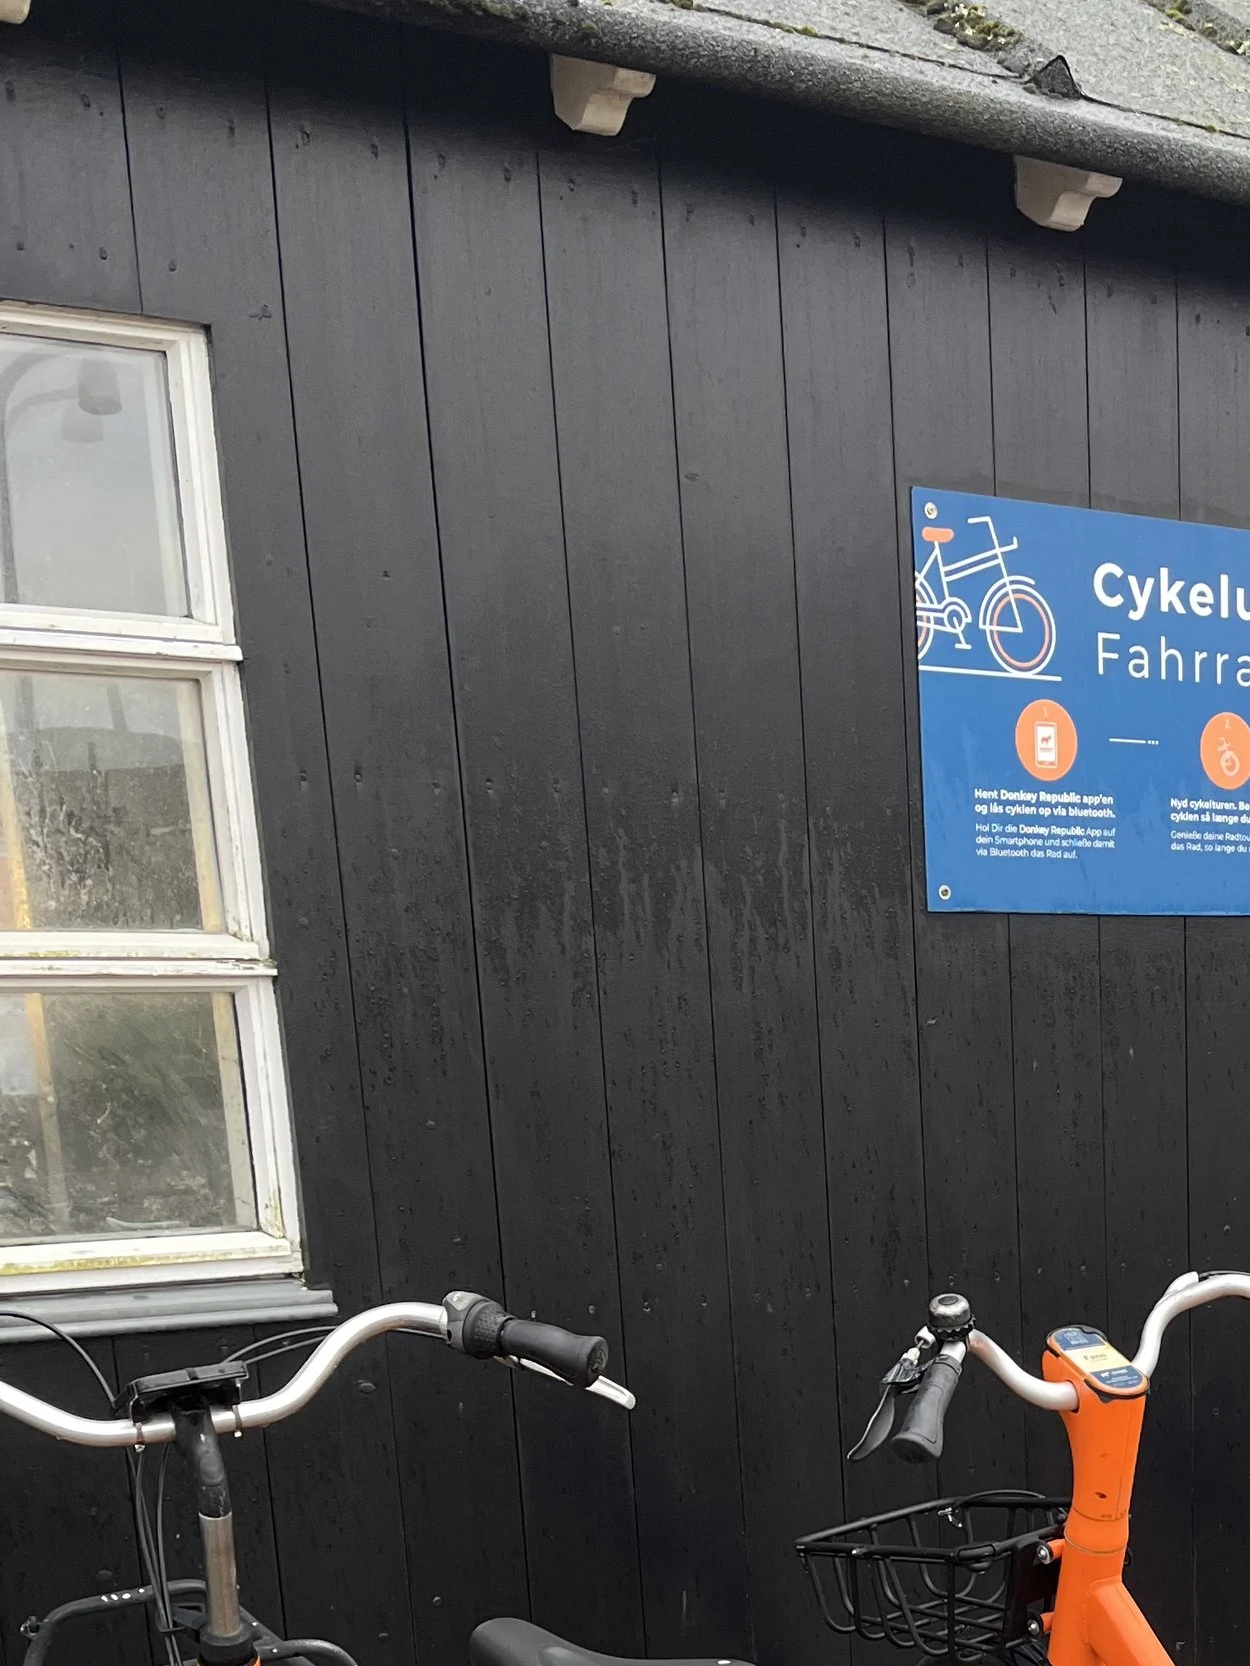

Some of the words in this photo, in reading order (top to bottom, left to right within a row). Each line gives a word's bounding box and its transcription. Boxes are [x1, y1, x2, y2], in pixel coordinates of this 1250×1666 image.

[974, 788, 998, 800] Hent
[1000, 789, 1037, 804] Donkey
[1039, 791, 1081, 804] Republic
[1082, 794, 1114, 806] app'en
[974, 804, 988, 815] og
[1005, 804, 1036, 816] cyklen
[1038, 807, 1051, 818] op
[1052, 805, 1067, 816] via
[1068, 806, 1116, 818] bluetooth.
[1170, 798, 1188, 810] Nyd
[1189, 799, 1237, 811] cykelturen.
[1170, 811, 1199, 823] cyklen
[1200, 811, 1210, 822] så
[1212, 812, 1238, 825] længe
[1240, 814, 1250, 824] du
[975, 823, 990, 832] Hol
[991, 823, 1003, 833] Dir
[1005, 824, 1017, 833] die
[1019, 824, 1049, 837] Donkey
[1050, 825, 1085, 837] Republic
[1086, 827, 1102, 838] App
[1103, 827, 1116, 837] auf
[975, 834, 993, 844] dein
[994, 835, 1043, 847] Smartphone
[1044, 838, 1060, 847] und
[1093, 839, 1115, 849] damit
[975, 847, 988, 856] via
[989, 847, 1029, 857] Bluetooth
[1030, 848, 1045, 858] das
[1046, 849, 1061, 858] Rad
[1063, 849, 1078, 859] auf.
